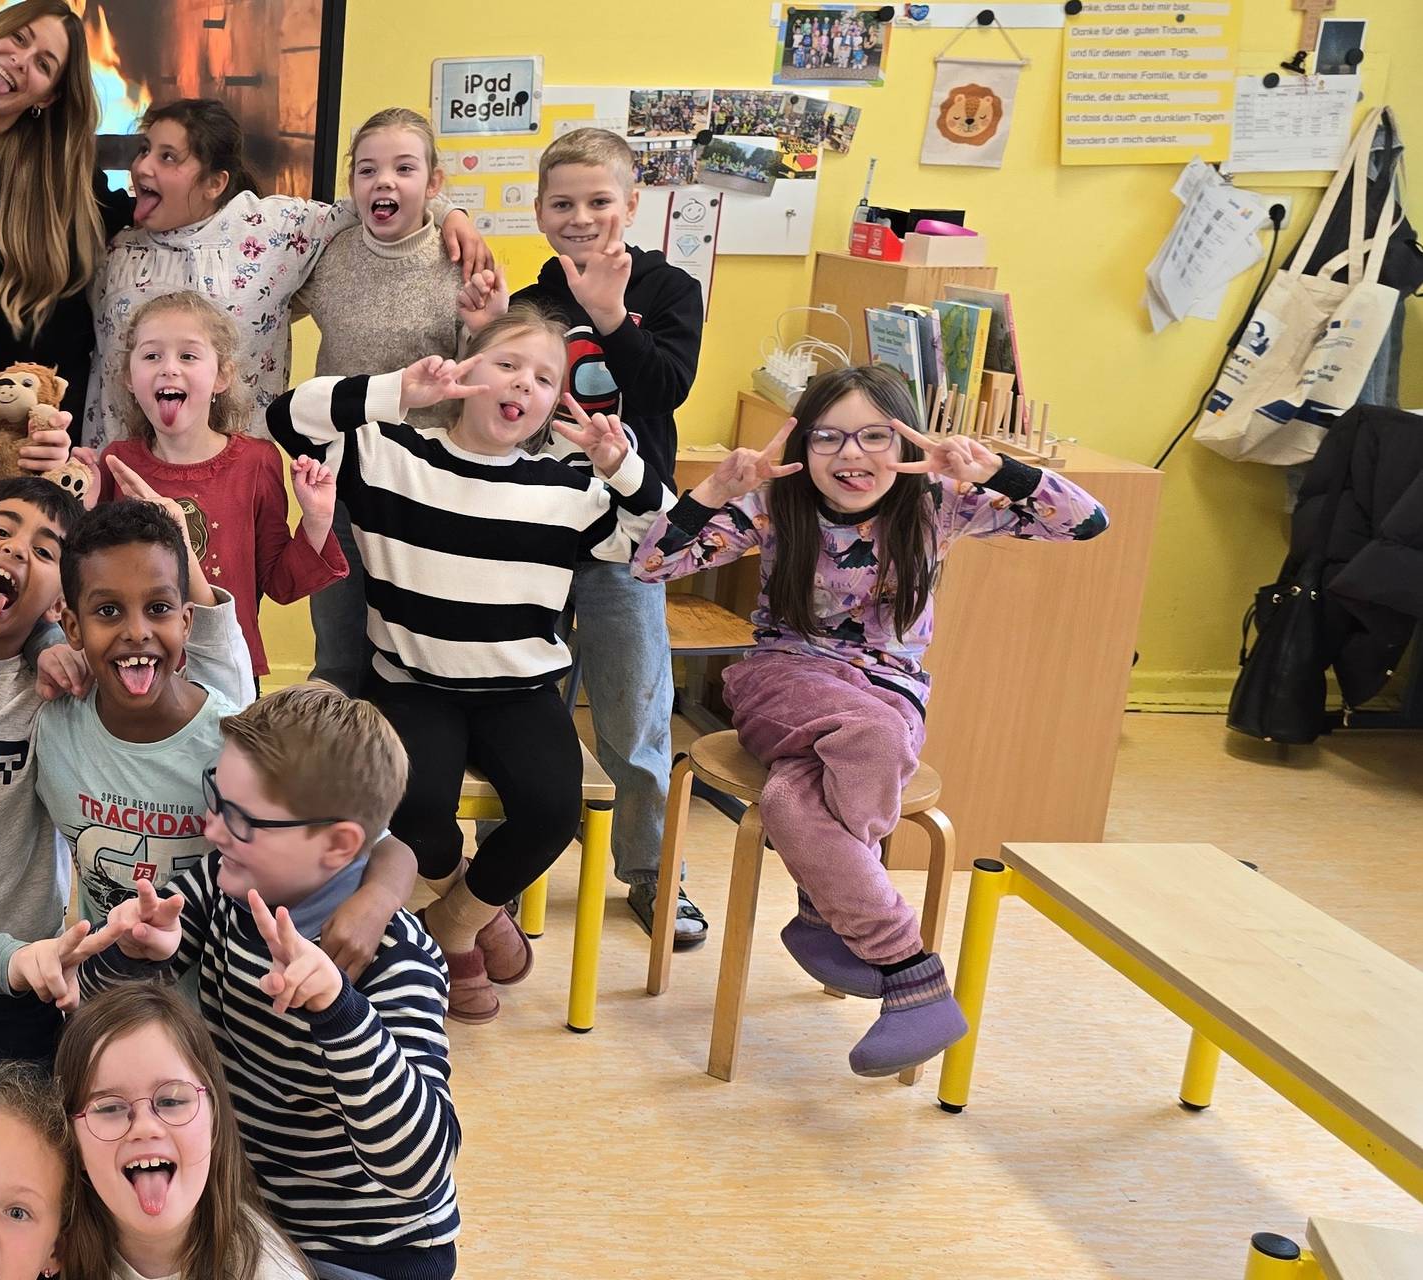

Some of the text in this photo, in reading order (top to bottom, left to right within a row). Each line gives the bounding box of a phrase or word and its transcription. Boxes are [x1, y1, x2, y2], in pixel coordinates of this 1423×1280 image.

[1071, 27, 1100, 36] Danke
[464, 73, 511, 94] iPad
[450, 98, 523, 121] Regeln
[78, 793, 207, 836] TRACKDAY
[101, 792, 194, 816] SPEED REVOLUTION
[136, 867, 153, 879] 73
